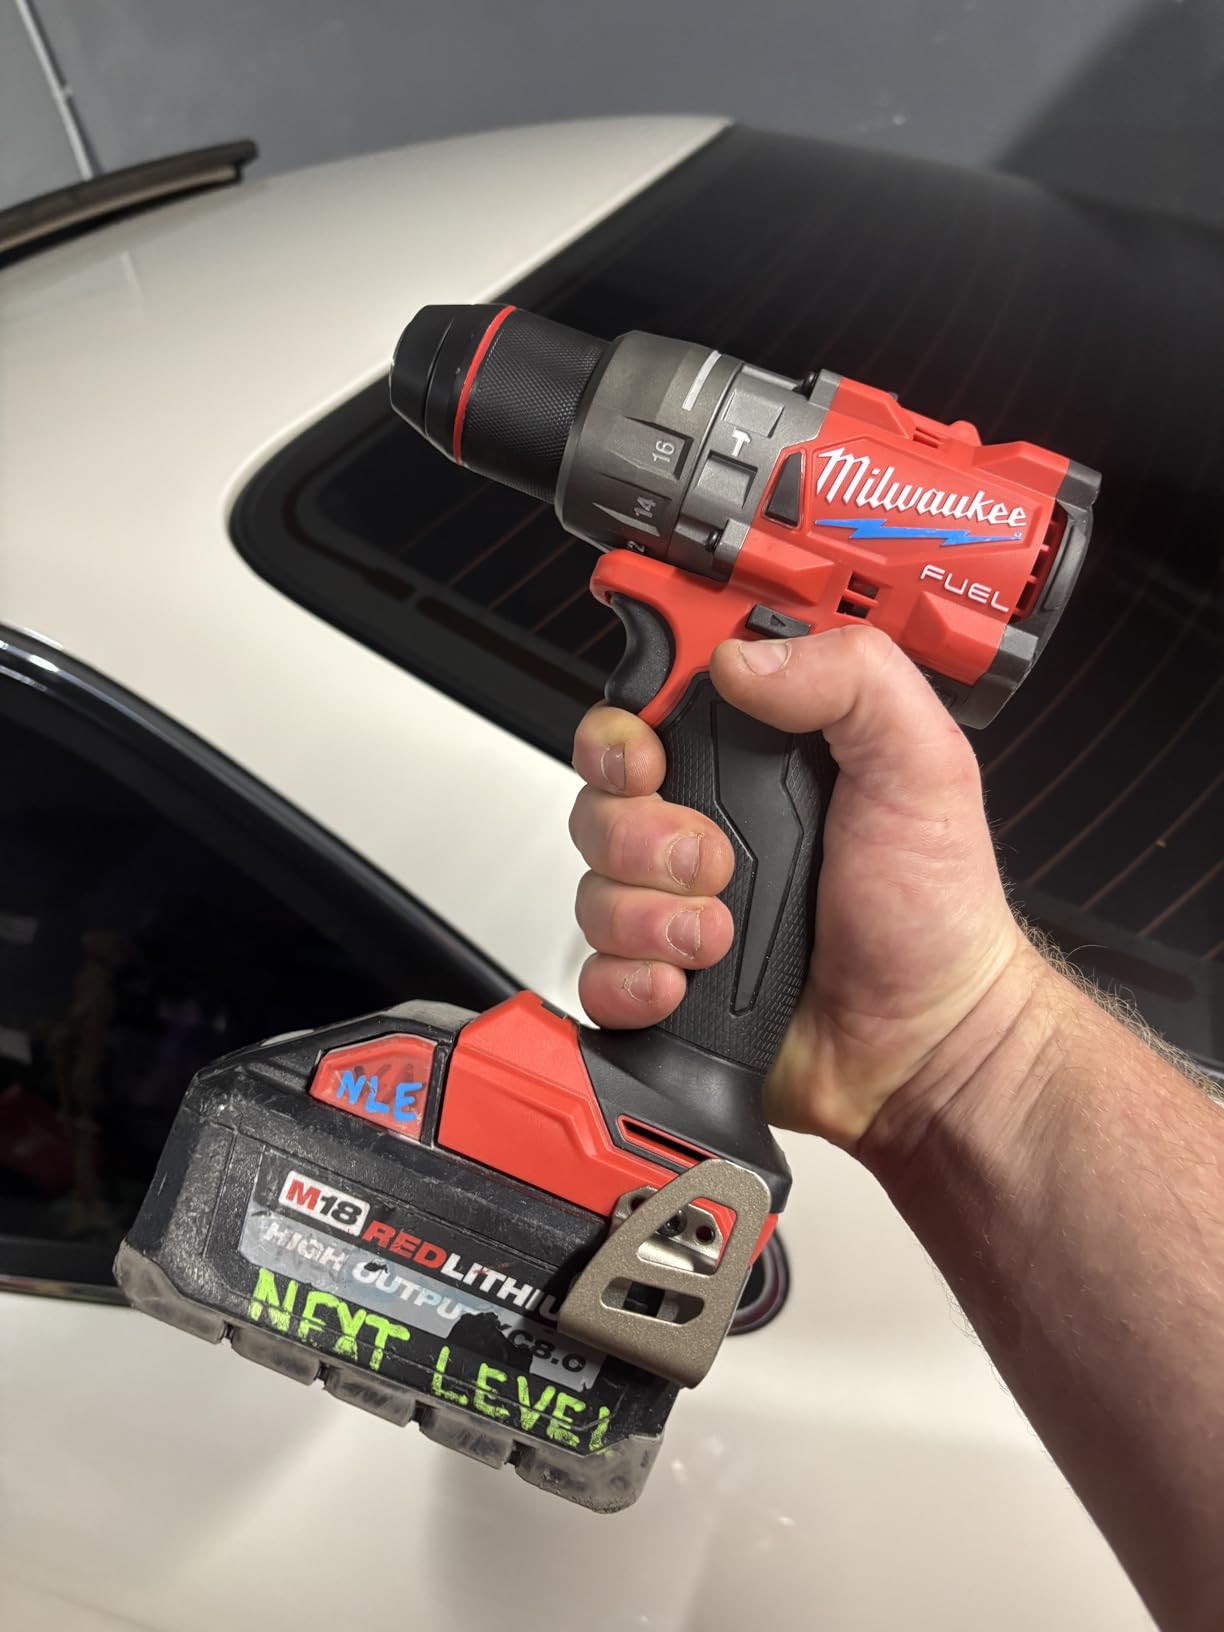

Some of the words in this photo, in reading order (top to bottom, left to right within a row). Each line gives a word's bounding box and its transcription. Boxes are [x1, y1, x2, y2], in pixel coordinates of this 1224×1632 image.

[652, 440, 675, 463] 16
[633, 496, 656, 519] 14
[816, 447, 1028, 527] Milwaukee
[627, 540, 646, 553] 2
[920, 564, 1010, 613] FUEL
[336, 1070, 423, 1122] NLE
[263, 1221, 348, 1273] HIGH
[351, 1258, 480, 1321] OUTPU
[285, 1178, 363, 1226] M18
[361, 1220, 562, 1321] REDLITHIU
[249, 1266, 411, 1372] NEXT
